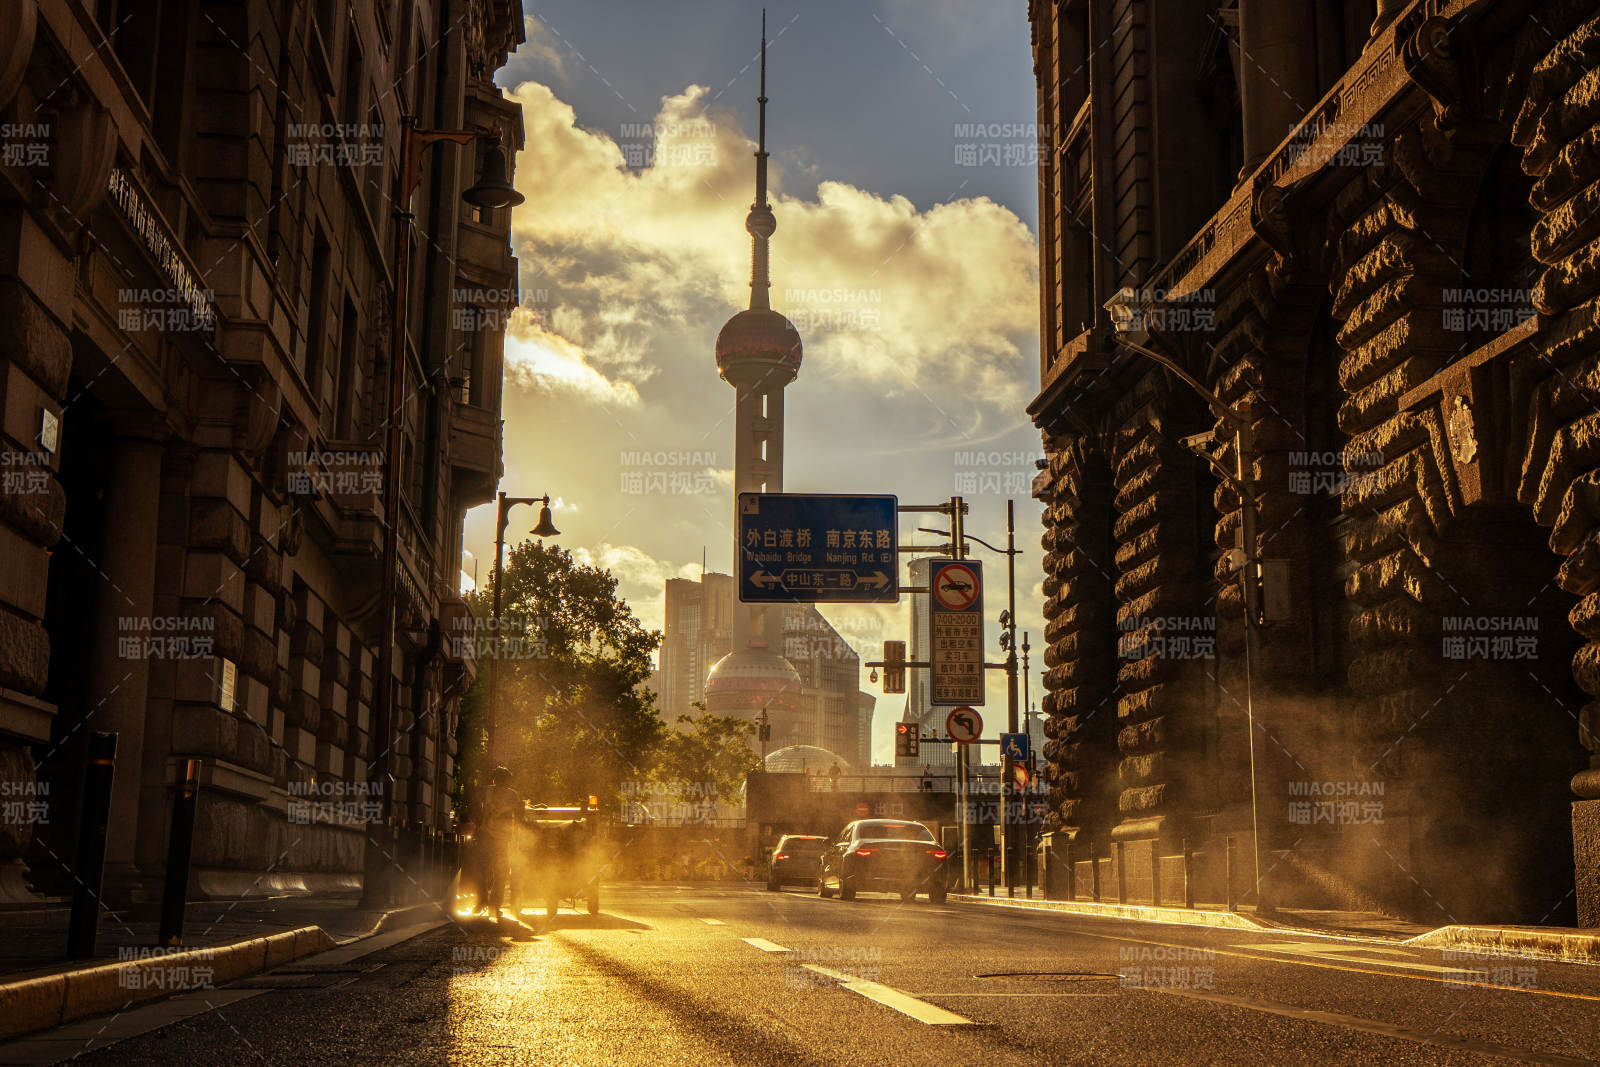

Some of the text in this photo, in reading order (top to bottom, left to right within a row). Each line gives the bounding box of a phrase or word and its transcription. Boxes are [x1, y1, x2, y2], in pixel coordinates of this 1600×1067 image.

[746, 528, 891, 549] 外白渡桥 南京东路
[747, 551, 782, 562] Waibaidu
[787, 551, 812, 563] Bridge
[826, 552, 857, 564] Nanjing
[861, 552, 874, 562] Rd.
[786, 573, 852, 586] 中山东一路
[874, 801, 904, 815] 出口
